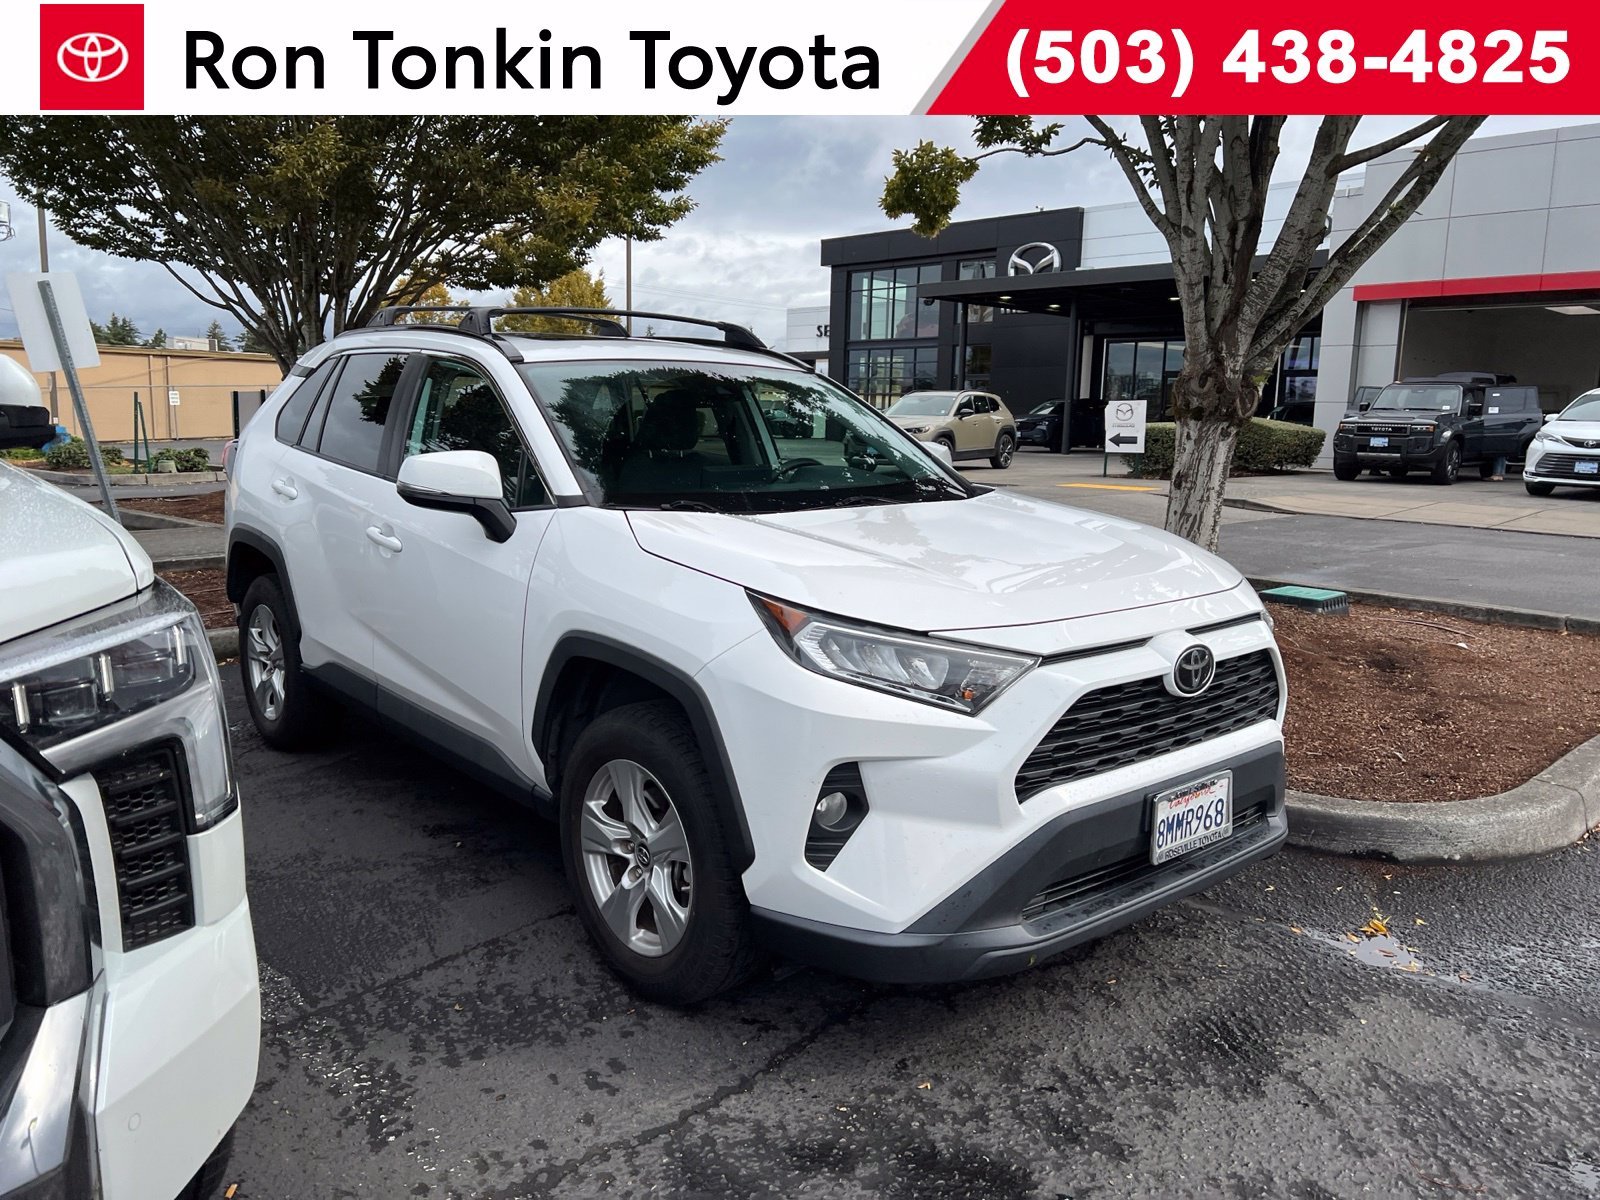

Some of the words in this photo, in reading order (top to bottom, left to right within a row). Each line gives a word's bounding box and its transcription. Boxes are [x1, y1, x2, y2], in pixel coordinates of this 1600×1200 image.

[1156, 797, 1225, 850] 8MMR968
[1164, 841, 1198, 860] ROSEVILLE
[1199, 830, 1223, 848] TOYOTA
